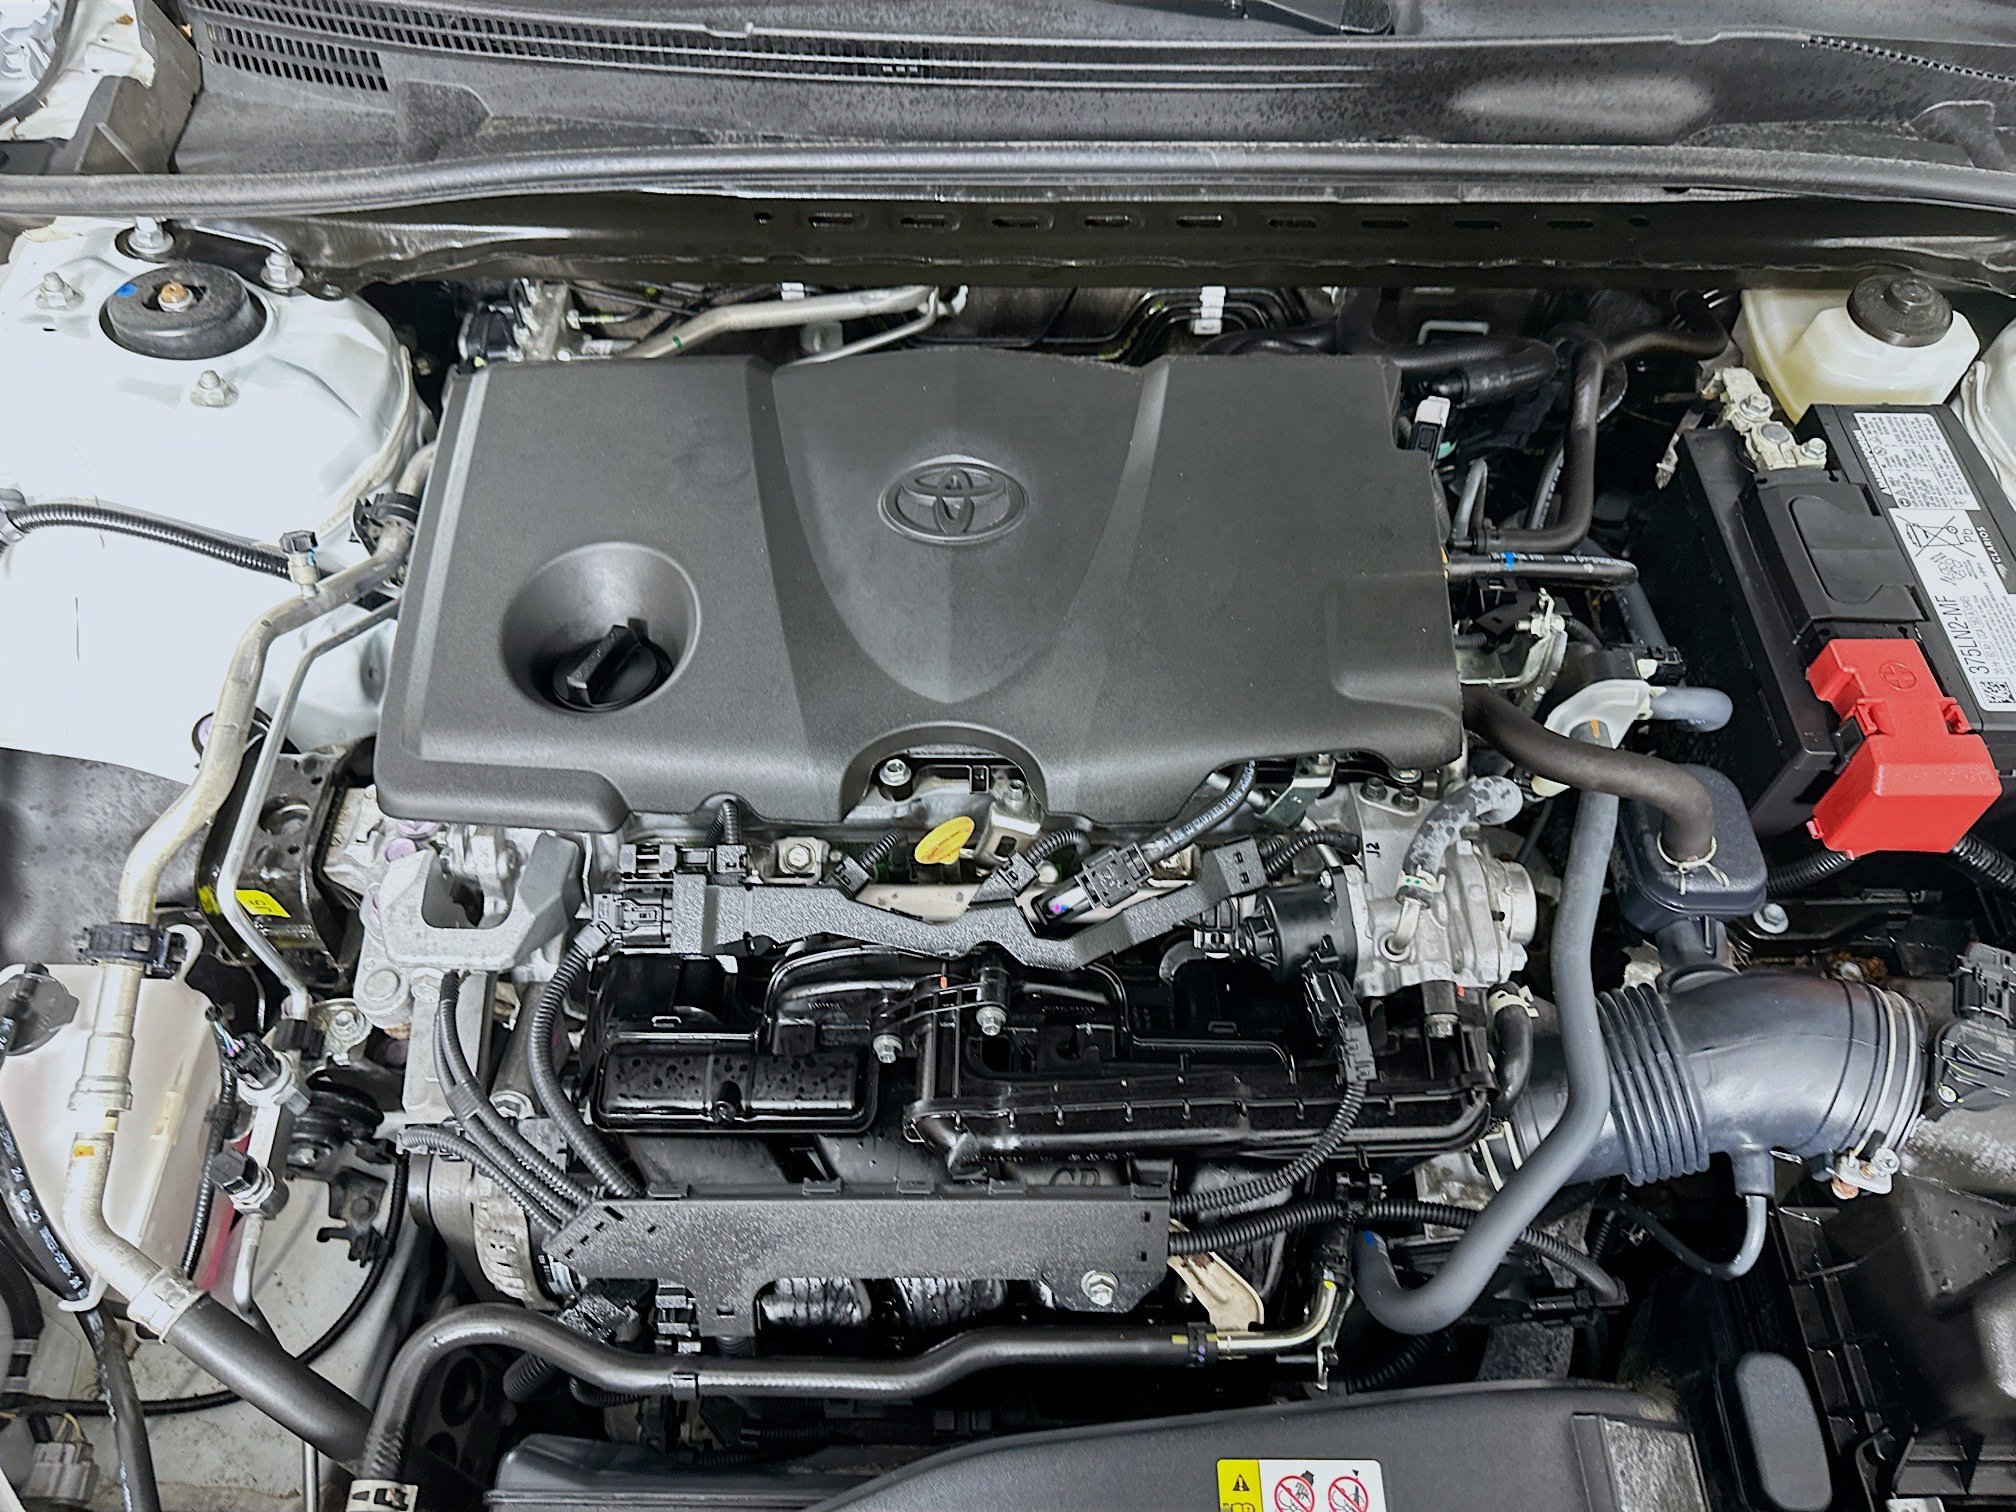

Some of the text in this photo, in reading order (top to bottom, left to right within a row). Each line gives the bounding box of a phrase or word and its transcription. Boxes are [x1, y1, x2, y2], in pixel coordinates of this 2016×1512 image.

[1961, 528, 1977, 543] Pb
[1976, 526, 2002, 563] CLARIOS
[1934, 595, 1990, 674] 375LN2-MF
